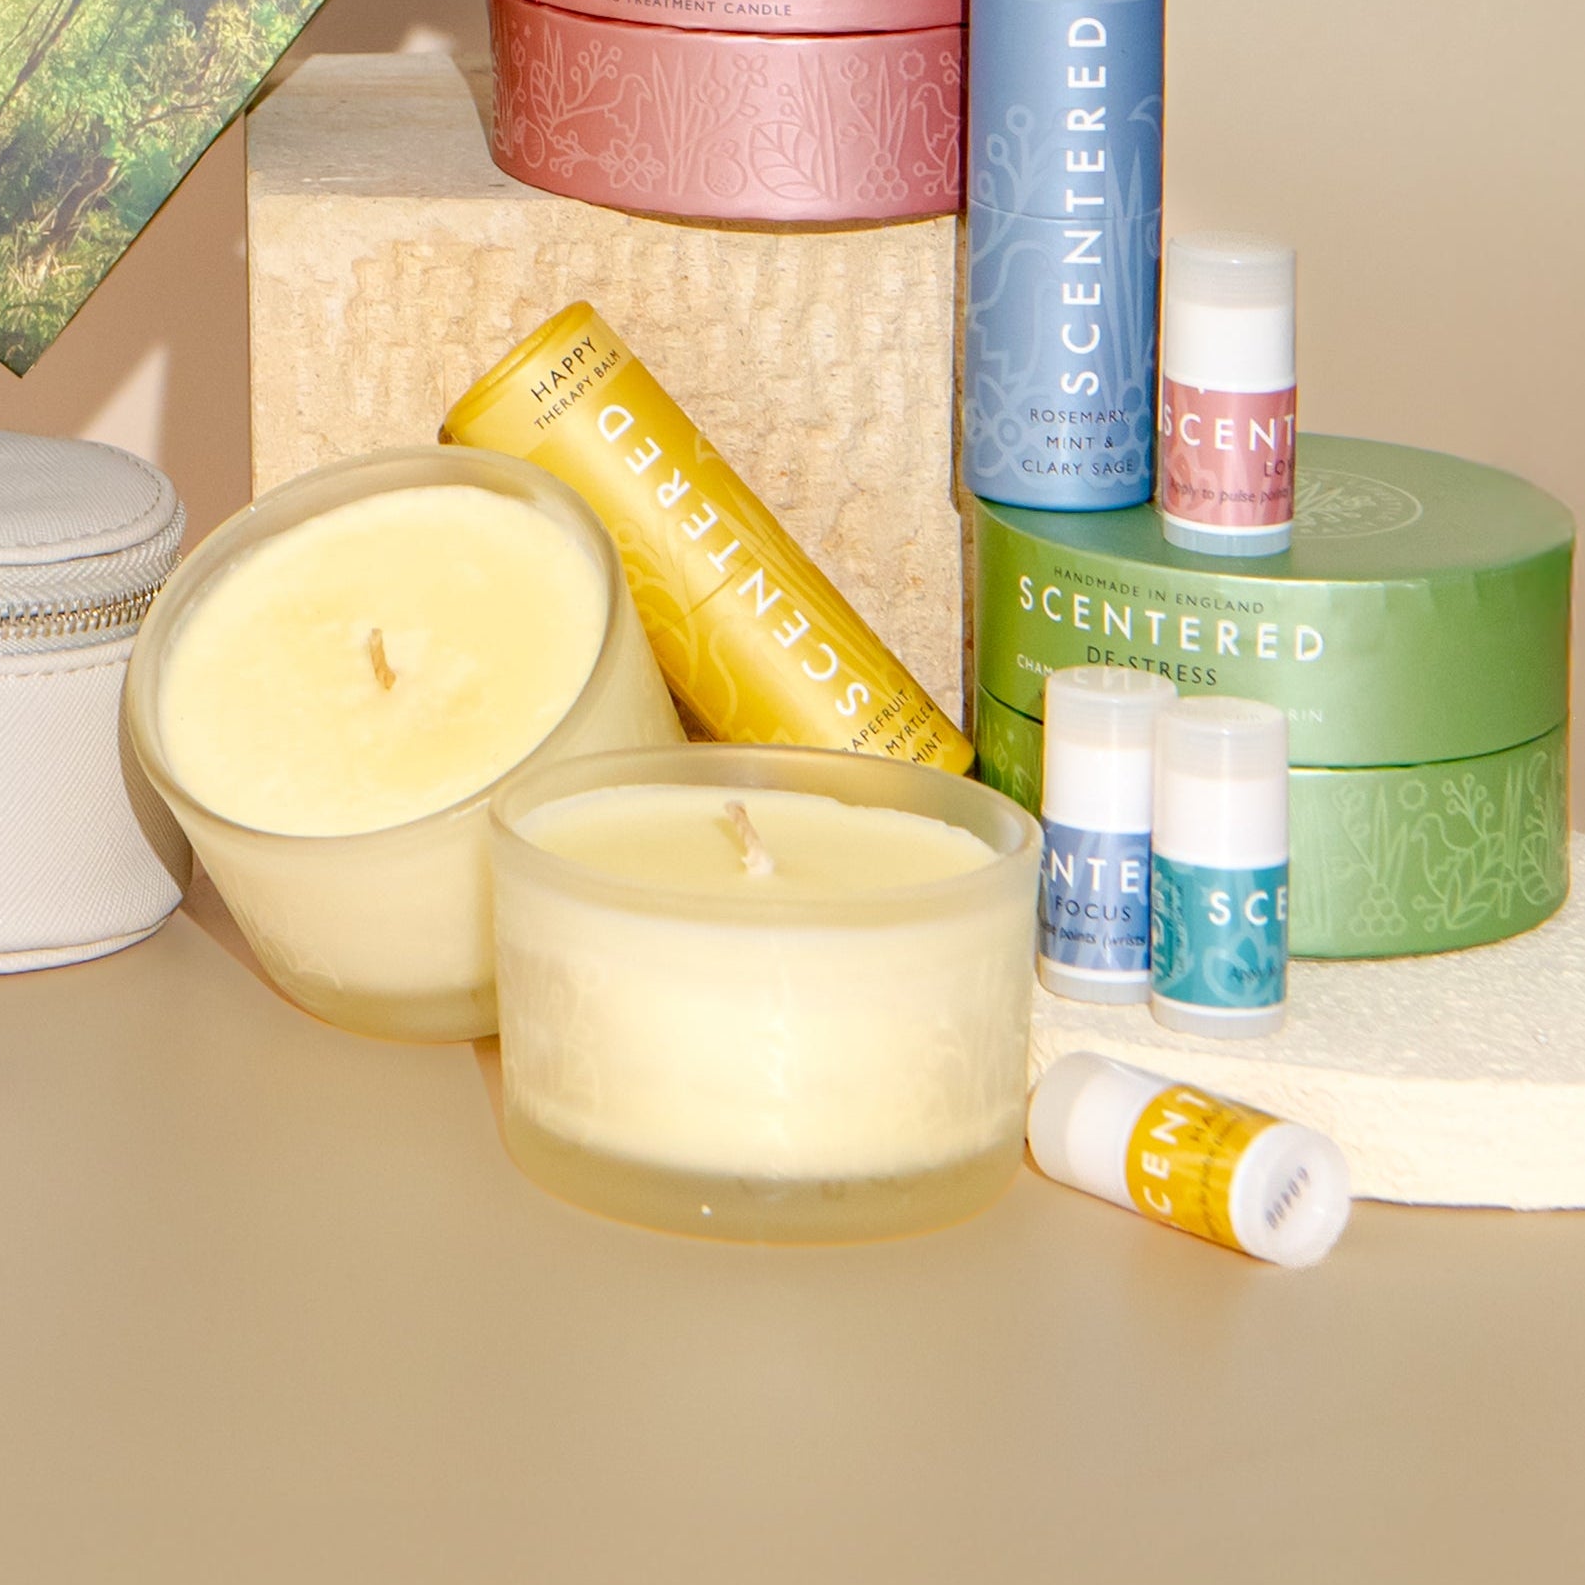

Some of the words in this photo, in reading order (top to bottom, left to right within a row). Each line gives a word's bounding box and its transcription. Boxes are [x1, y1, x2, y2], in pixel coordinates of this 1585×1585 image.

[723, 1, 793, 17] CANDLE
[1060, 16, 1108, 397] SCENTERED
[529, 335, 599, 404] HAPPY
[533, 376, 595, 431] THERAPY
[593, 348, 623, 381] BALM
[1029, 407, 1131, 425] ROSEMARY,
[1046, 434, 1096, 451] MINT
[1103, 435, 1115, 450] &
[1021, 458, 1083, 477] CLARY
[1091, 458, 1135, 477] SAGE
[1202, 487, 1216, 500] to
[1218, 487, 1256, 504] pulse
[596, 403, 871, 716] SCENTERED
[1053, 565, 1141, 599] HANDMADE
[1147, 587, 1167, 603] IN
[1175, 591, 1266, 616] ENGLAND
[1018, 574, 1325, 663] SCENTERED
[1086, 645, 1218, 687] DE-STRESS
[884, 706, 930, 756] MYRTLE
[911, 731, 943, 765] MINT
[1054, 894, 1132, 923] FOCUS
